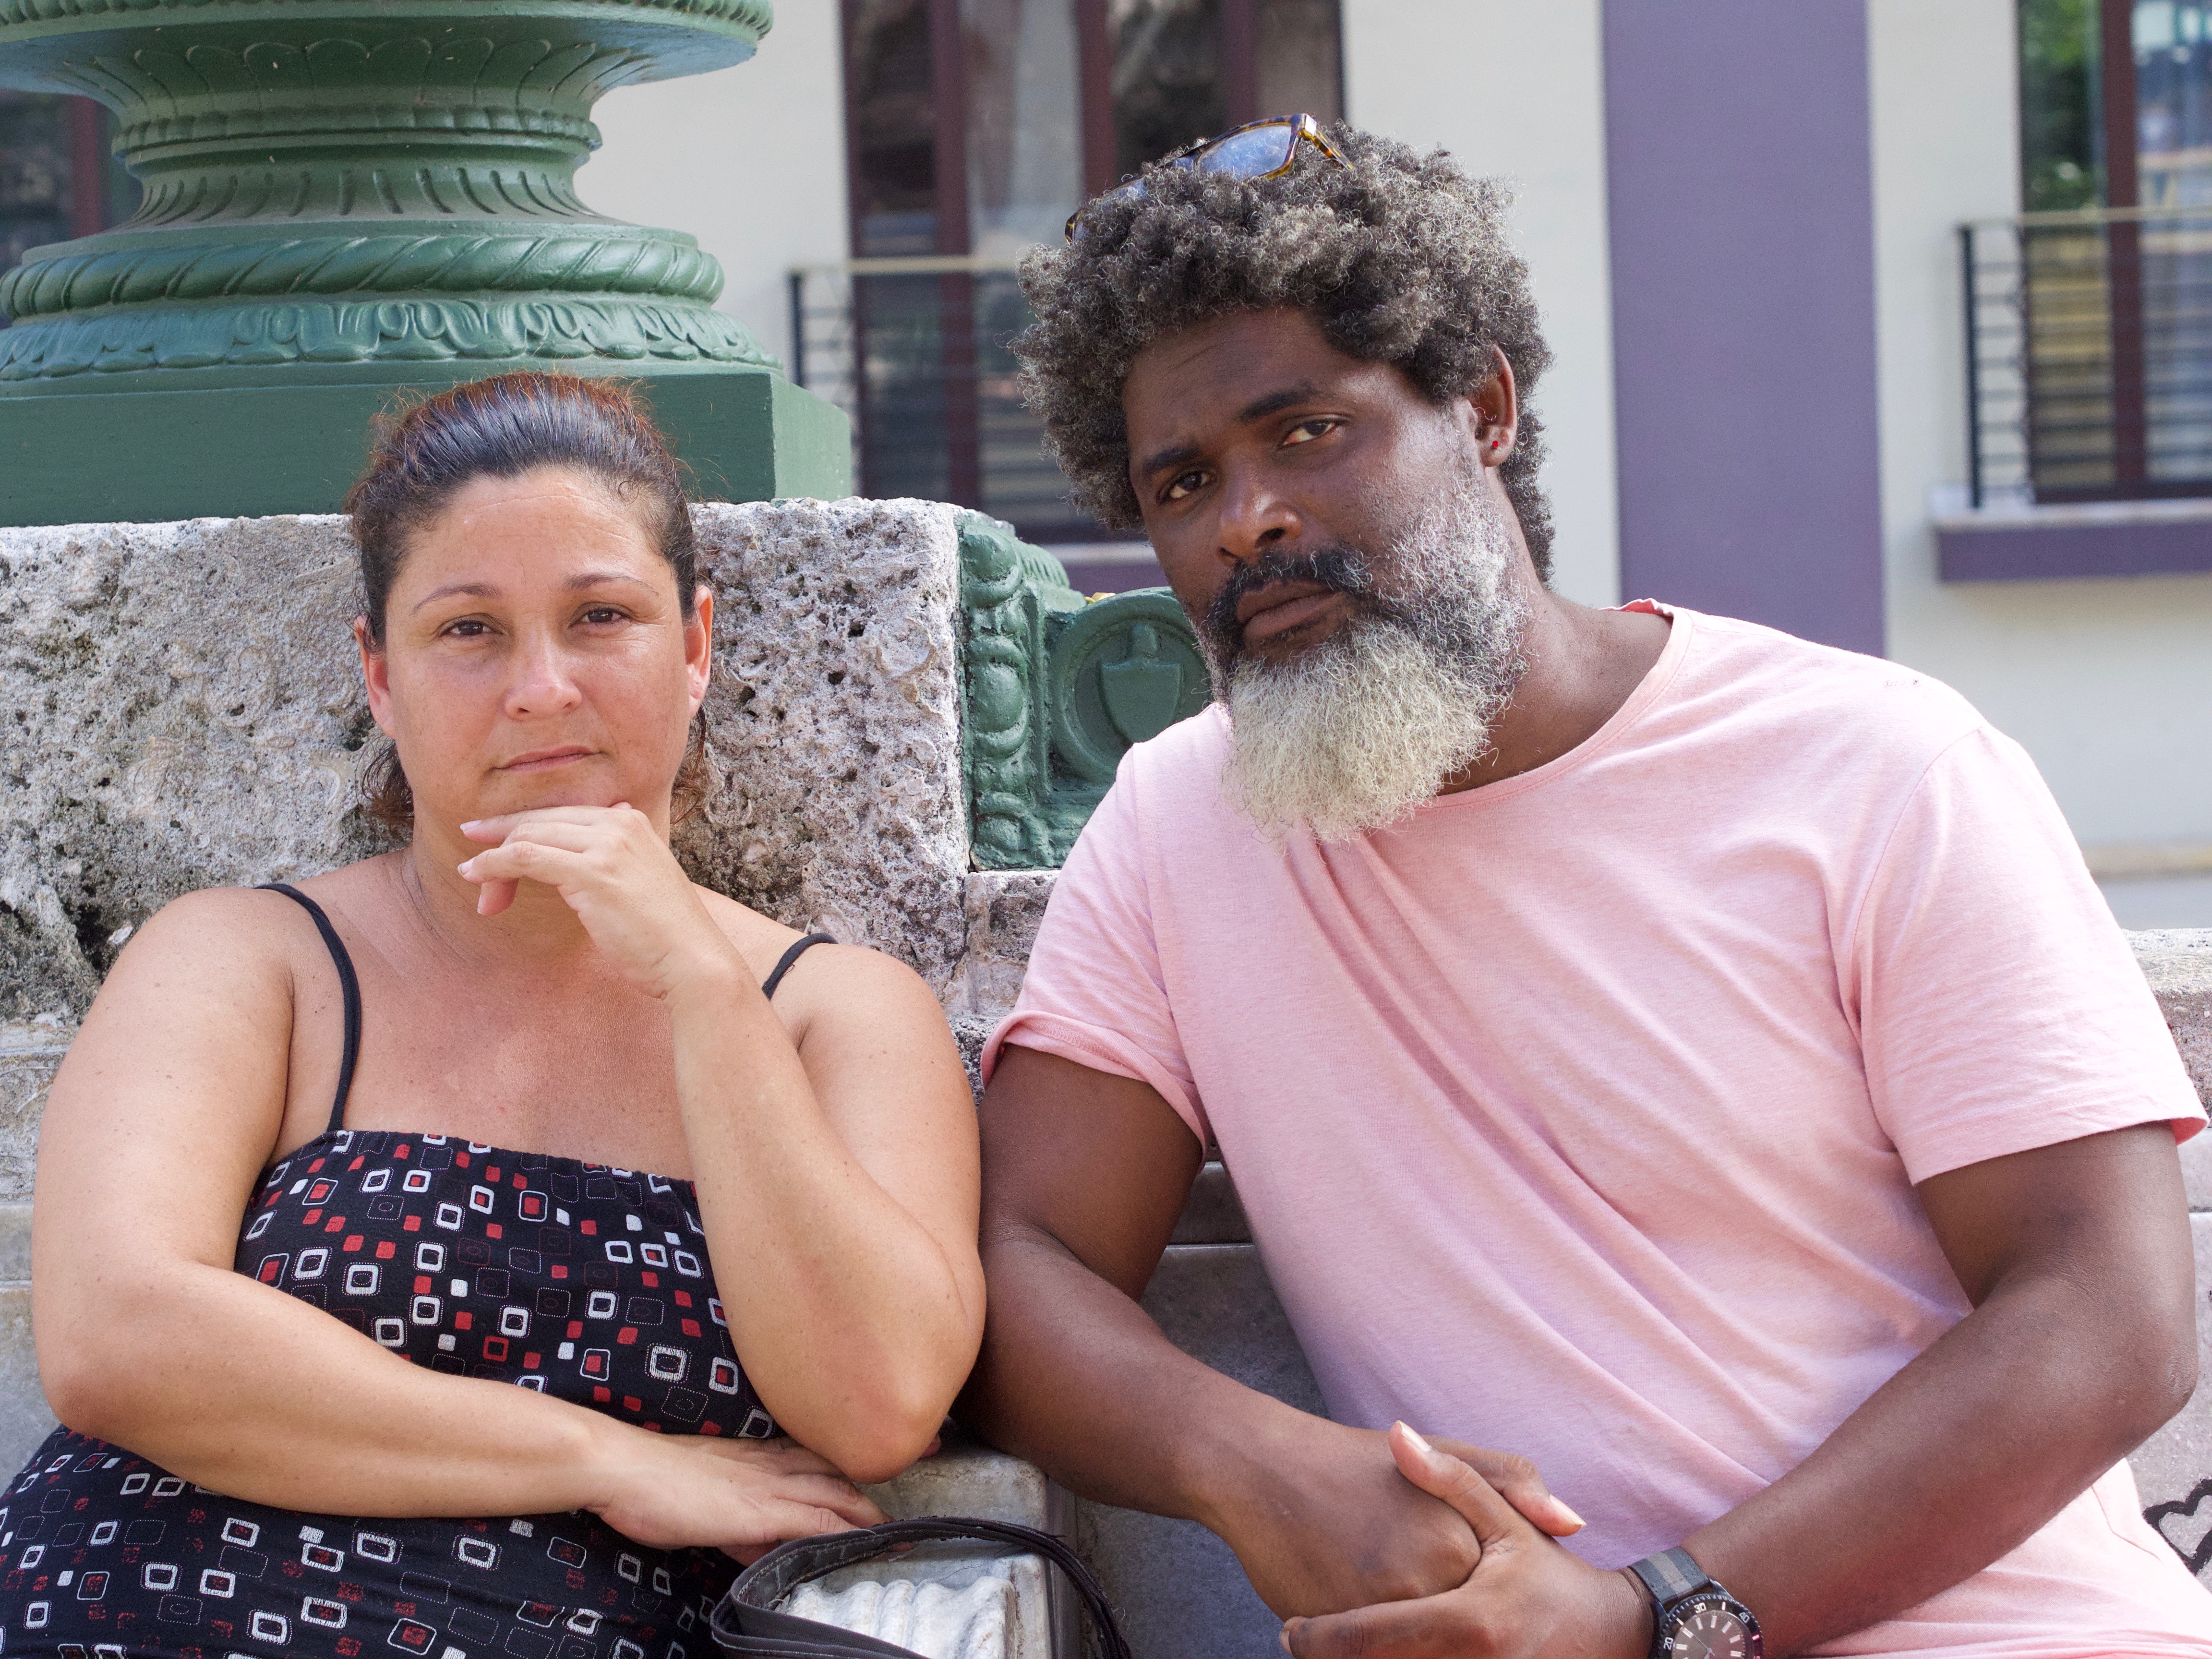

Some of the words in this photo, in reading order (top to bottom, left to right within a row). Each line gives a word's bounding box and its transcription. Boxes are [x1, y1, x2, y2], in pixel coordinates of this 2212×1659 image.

[1694, 1602, 1707, 1613] 30
[1739, 1612, 1750, 1623] 40
[1663, 1637, 1673, 1650] 20
